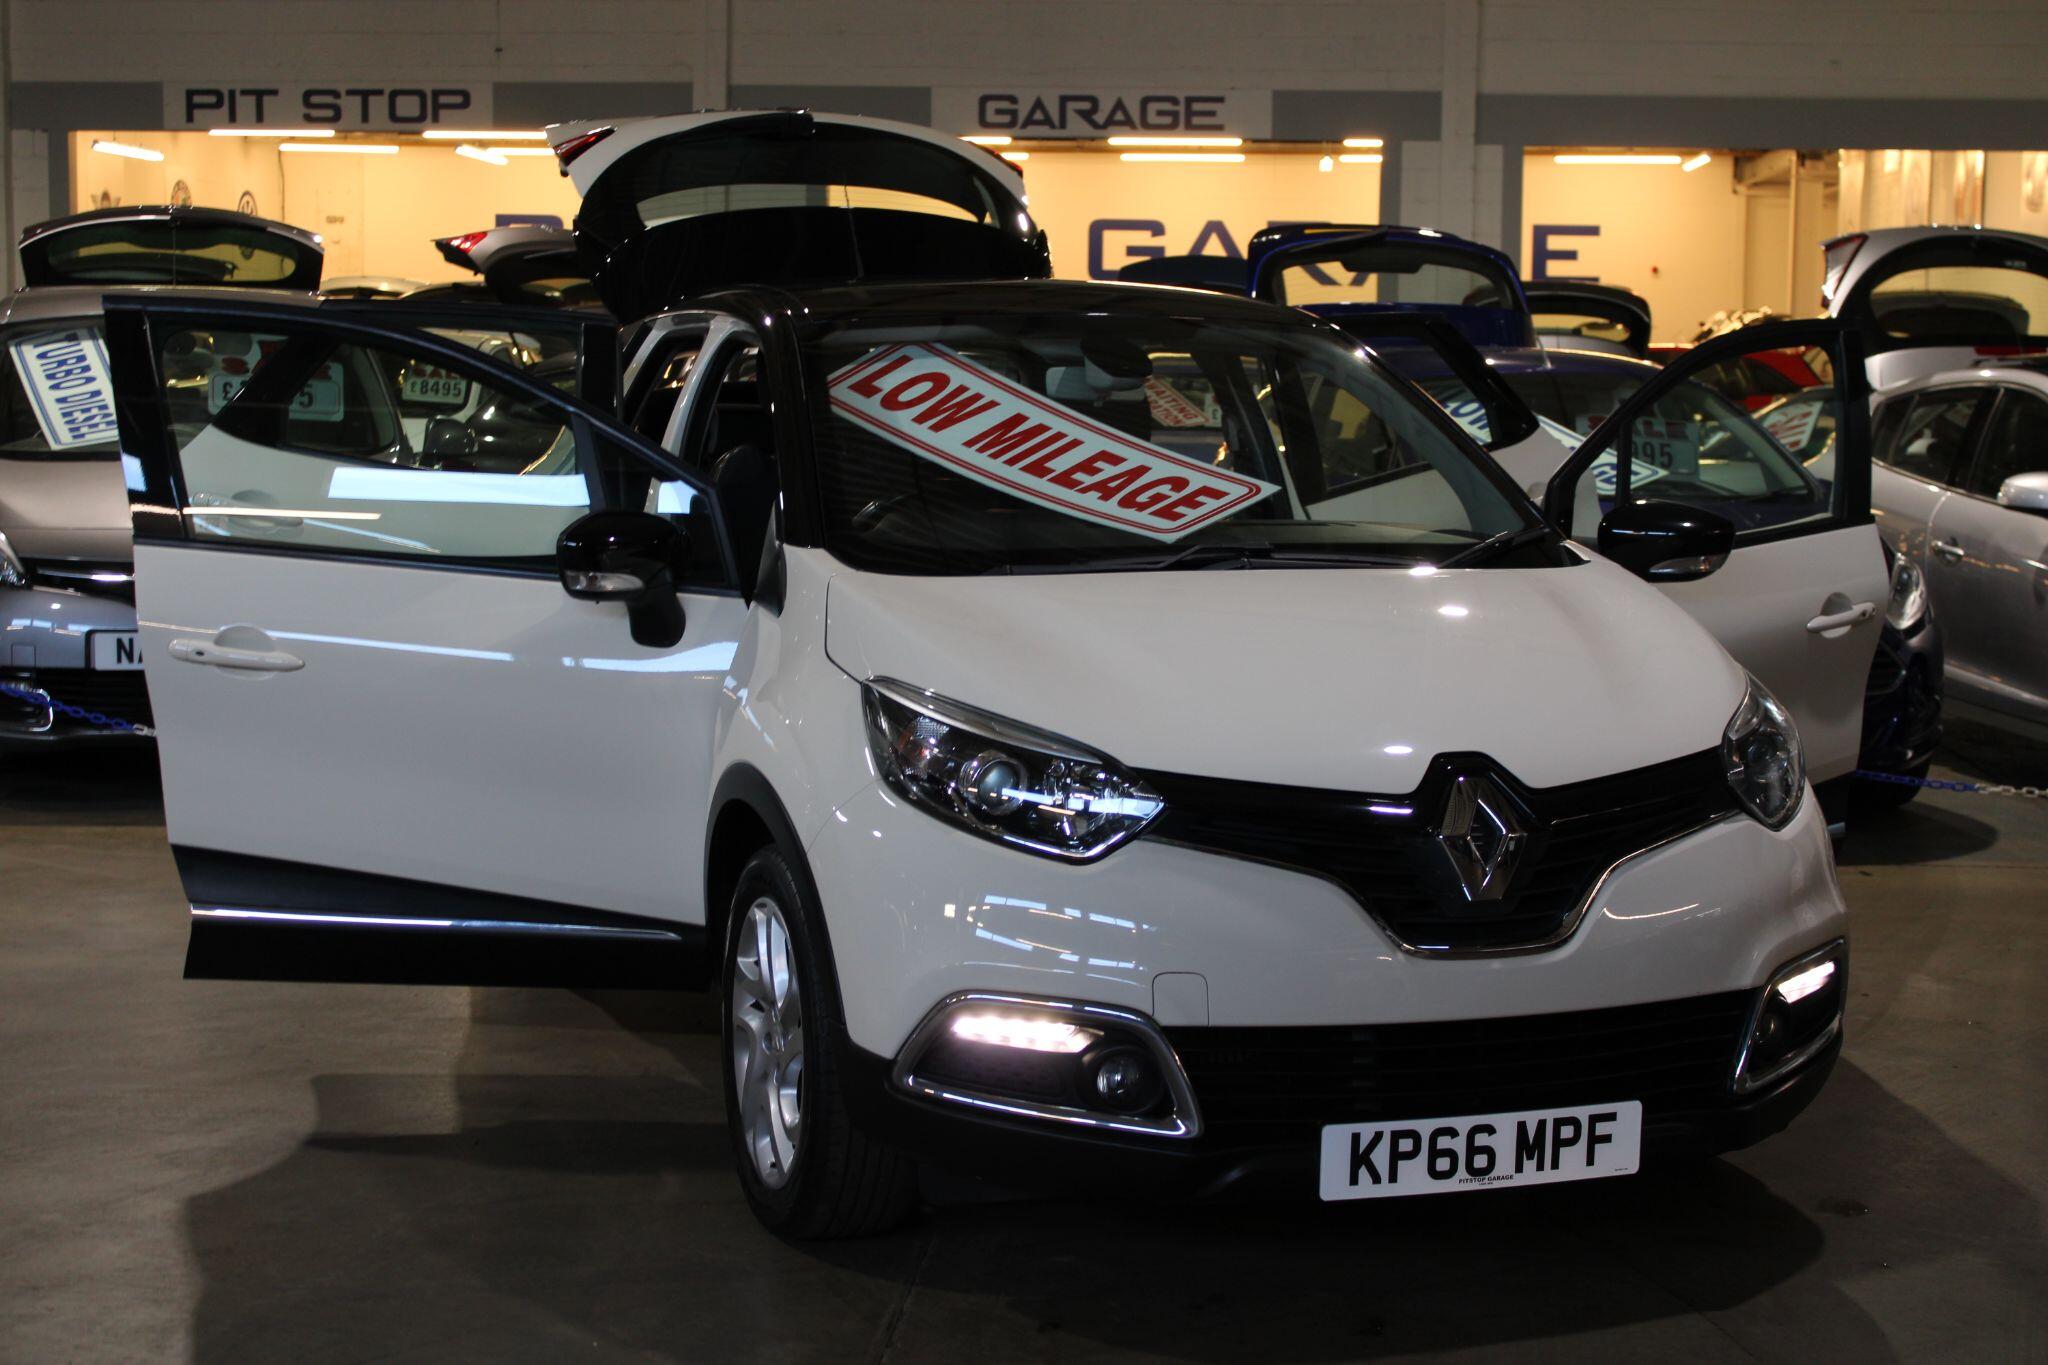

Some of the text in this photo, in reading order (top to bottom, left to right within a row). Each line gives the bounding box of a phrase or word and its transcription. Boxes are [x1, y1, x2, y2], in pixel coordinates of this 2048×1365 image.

[186, 89, 471, 124] PIT STOP
[978, 95, 1226, 131] GARAGE
[33, 332, 118, 439] TURBO DIESEL
[847, 355, 1231, 522] LOW MILEAGE
[1349, 1112, 1618, 1186] KP66 MPF
[1459, 1176, 1487, 1184] PITSTOP
[1487, 1174, 1514, 1182] GARAGE
